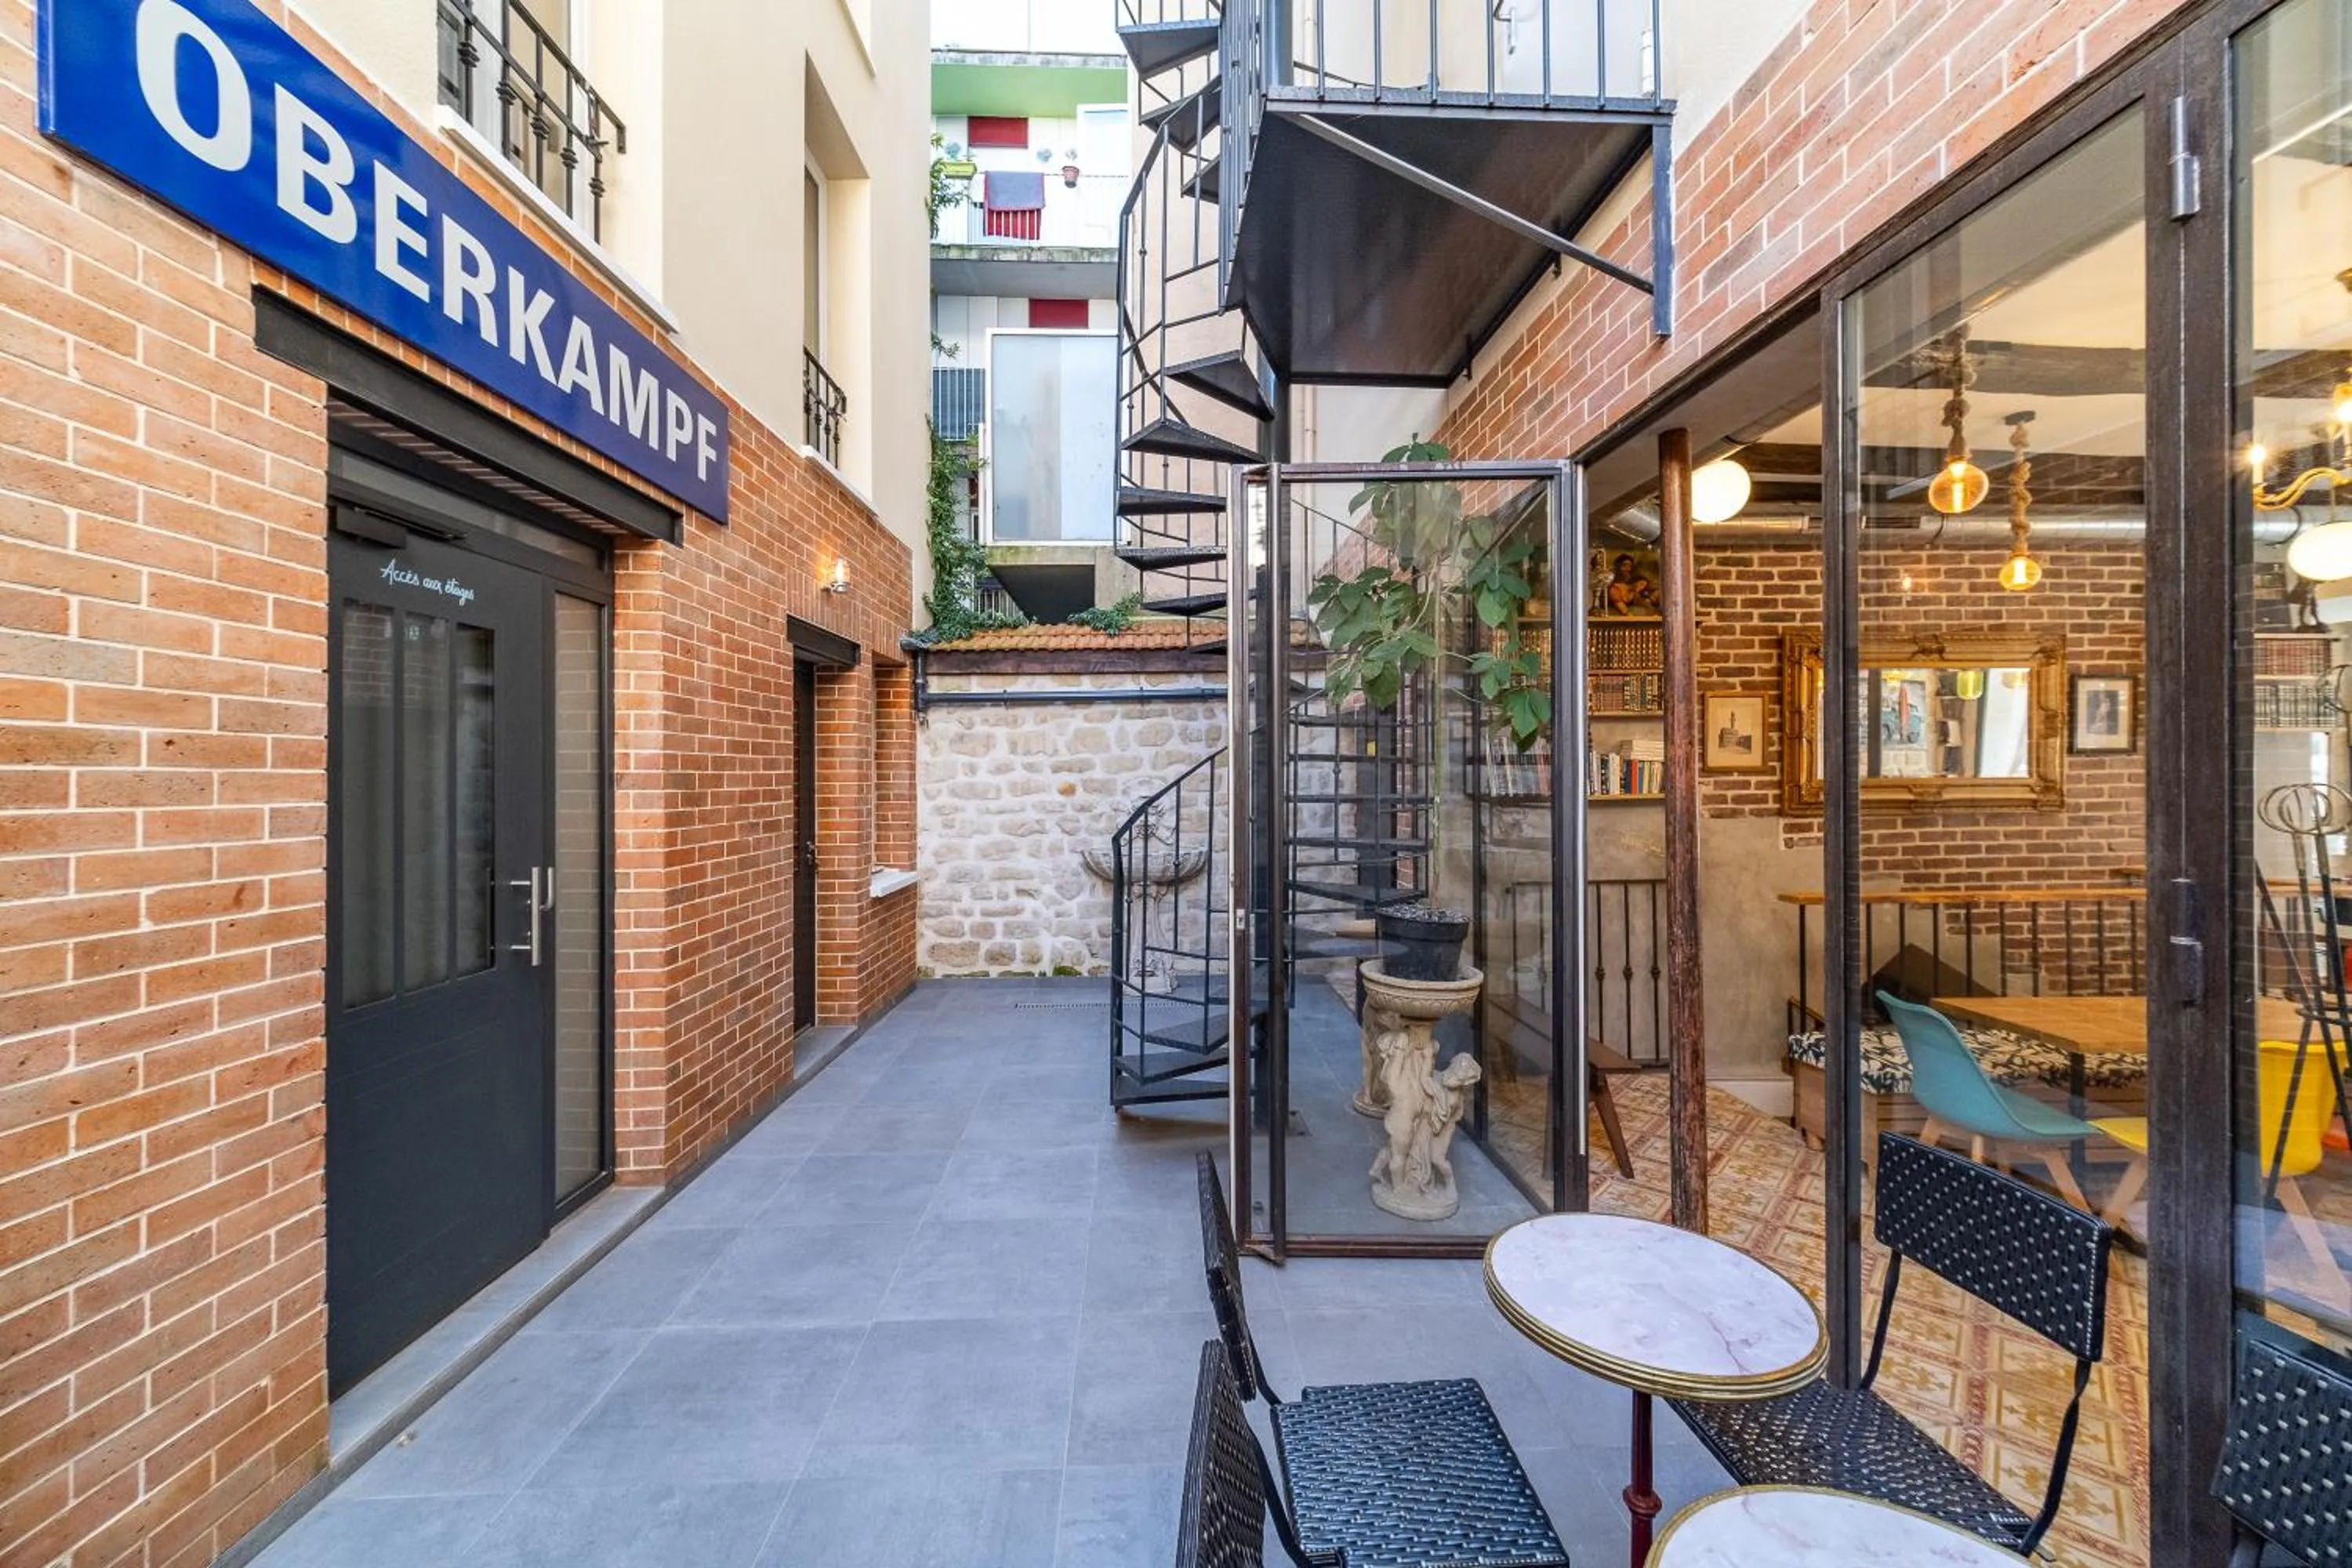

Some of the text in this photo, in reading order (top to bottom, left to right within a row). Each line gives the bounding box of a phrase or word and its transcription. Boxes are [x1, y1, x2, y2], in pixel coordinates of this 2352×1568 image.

[136, 0, 717, 483] OBERKAMPF
[380, 558, 474, 606] Accès aux étages
